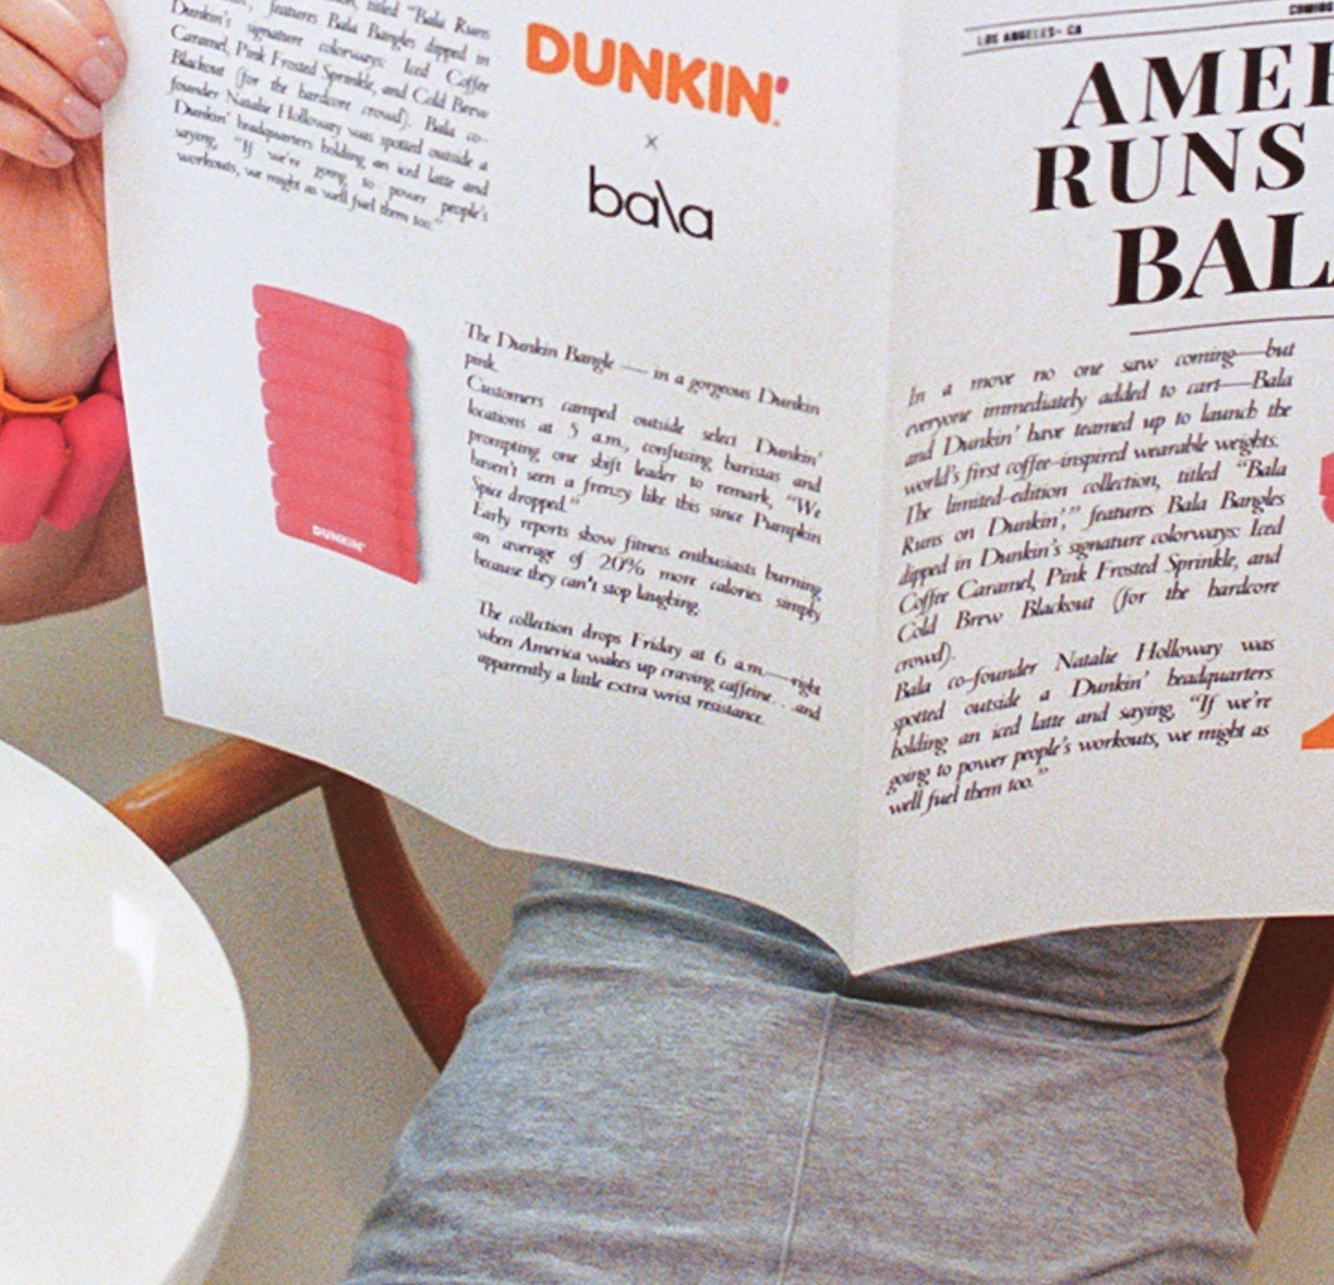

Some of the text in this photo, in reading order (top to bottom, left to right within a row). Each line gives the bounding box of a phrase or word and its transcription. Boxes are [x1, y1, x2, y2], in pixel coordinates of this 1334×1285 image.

[526, 22, 789, 125] DUNKIN'
[1030, 120, 1307, 213] RUNS
[467, 322, 820, 415] The Dunkin Bangle in a gorgeous Dunkin
[909, 386, 926, 403] In
[942, 383, 953, 396] a
[970, 373, 1016, 389] move
[1033, 368, 1056, 381] no
[1073, 362, 1104, 376] one
[1122, 358, 1159, 370] saw
[466, 374, 823, 466] Customers camped outside select Dunkin'
[904, 397, 1293, 464] and Dunkin' have teamed up to launch the
[906, 409, 972, 437] everyone
[983, 387, 1087, 417] immediately
[1098, 379, 1150, 402] added
[1159, 384, 1177, 395] to
[467, 398, 822, 493] locations at 5 a.m., confusing baristas and
[468, 429, 541, 462] prompting
[551, 451, 578, 463] one
[590, 451, 621, 475] shift
[634, 458, 677, 482] leader
[689, 469, 704, 488] to
[716, 483, 772, 509] remark,
[470, 448, 822, 544] haven't seen a frenzy like this since Pumpkin
[473, 475, 503, 498] Spice
[901, 535, 943, 553] Runs
[953, 527, 975, 542] on
[1089, 504, 1154, 526] features
[1166, 491, 1208, 513] Bala
[1220, 486, 1285, 514] Bangles
[906, 501, 932, 523] The
[945, 481, 1068, 514] limited-edition
[1082, 471, 1160, 494] collection,
[1177, 460, 1220, 483] titled
[472, 500, 822, 601] Early reports show fitness enthusiasts burning
[473, 548, 700, 616] because they can't stop laughing.
[898, 512, 1285, 588] dipped in Dunkin's signature colorways: Iced
[897, 575, 1280, 642] Cold Brew Blackout (for the hardcore
[893, 664, 1274, 736] spotted outside a Dunkin' headquarters
[894, 637, 1275, 700] Bala co-founder Natalie Holloway was
[890, 732, 949, 759] holding
[958, 731, 981, 744] an
[991, 714, 1022, 738] iced
[1030, 711, 1066, 731] latte
[1075, 701, 1109, 725] and
[1118, 703, 1175, 725] saying,
[1226, 690, 1273, 709] we're
[889, 786, 923, 814] well
[927, 778, 960, 812] fuel
[963, 780, 1003, 799] them
